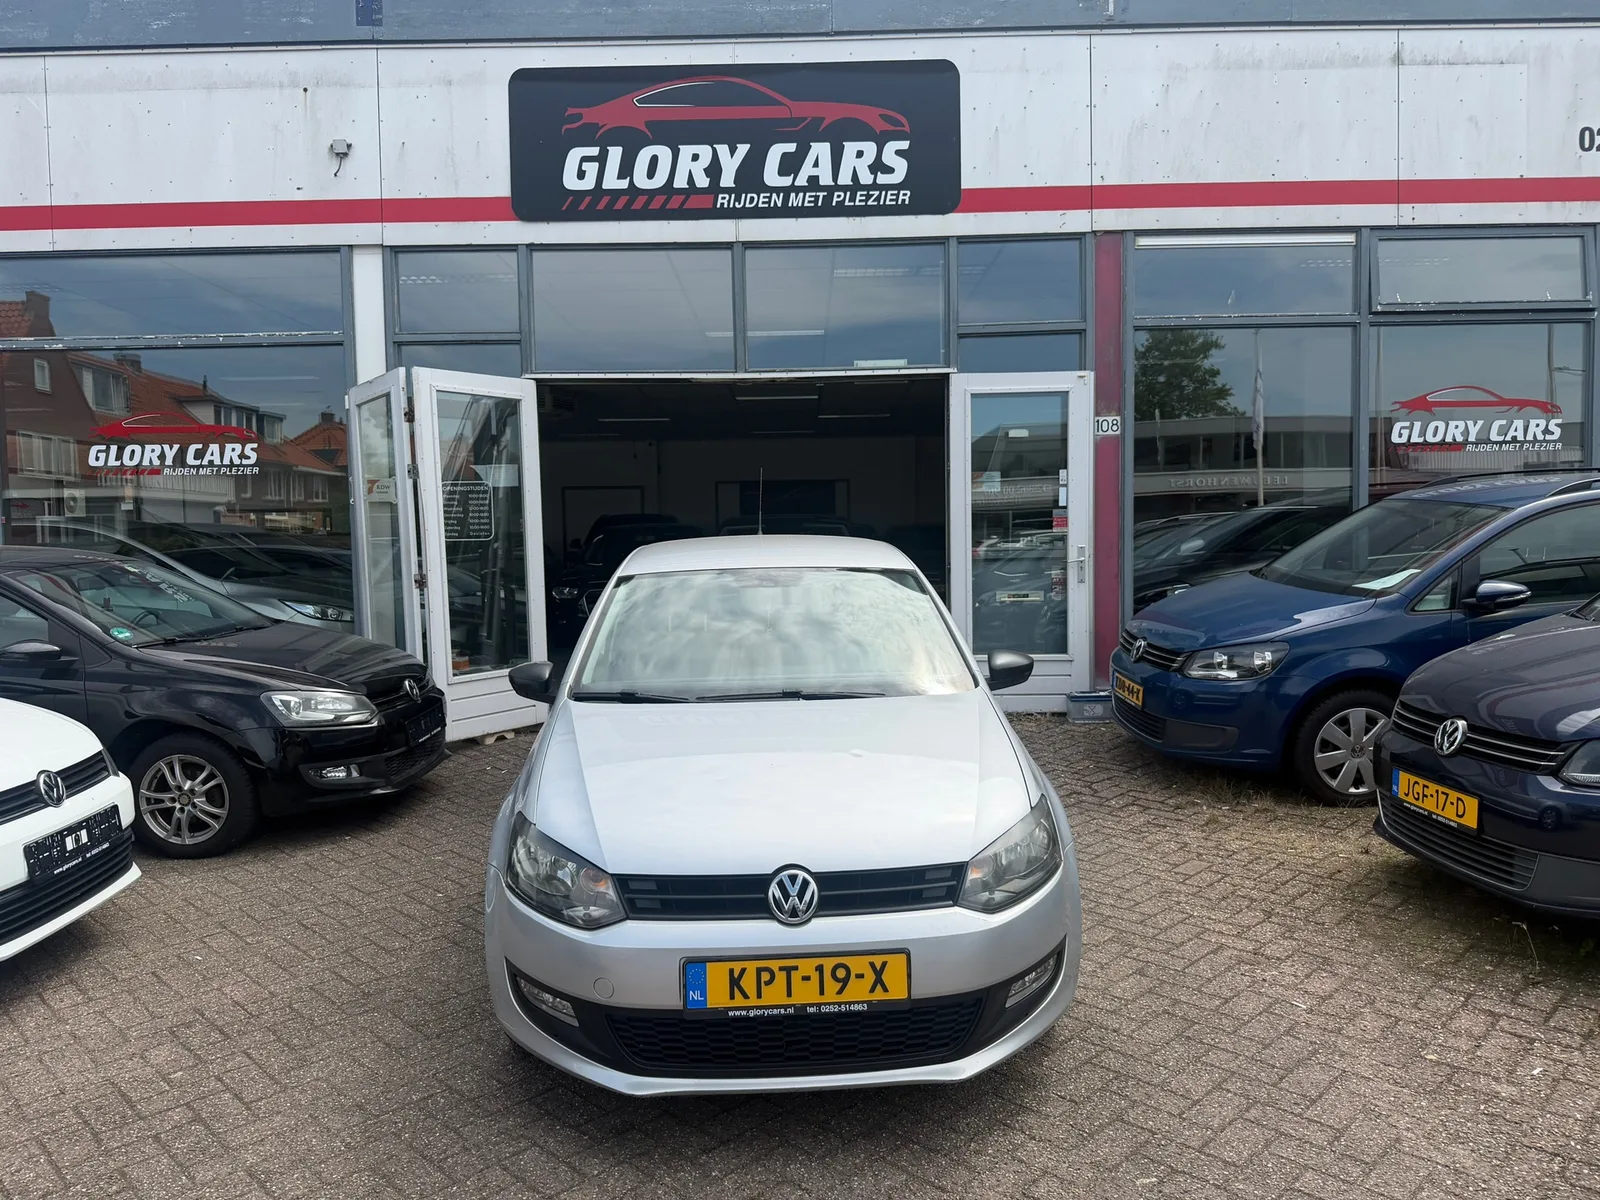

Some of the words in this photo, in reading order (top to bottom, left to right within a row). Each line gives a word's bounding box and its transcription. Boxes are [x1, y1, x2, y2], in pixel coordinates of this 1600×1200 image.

[1578, 126, 1600, 152] 0
[562, 143, 752, 190] GLORY
[763, 140, 911, 188] CARS
[716, 192, 786, 209] RIJDEN
[788, 191, 828, 207] MET
[831, 190, 911, 206] PLEZIER
[1095, 418, 1120, 433] 108
[1391, 420, 1485, 444] GLORY
[1489, 418, 1563, 442] CARS
[88, 443, 180, 467] GLORY
[186, 443, 259, 466] CARS
[1465, 444, 1499, 452] RIJDEN
[1501, 443, 1521, 451] MET
[1523, 442, 1563, 450] PLEZIER
[163, 468, 197, 476] RIJDEN
[198, 467, 218, 475] MET
[220, 467, 259, 475] PLEZIER
[1403, 778, 1467, 819] JGF-17-D
[728, 960, 890, 1001] KPT-19-X
[689, 990, 705, 1001] NL
[728, 1006, 795, 1017] www.glorycars.nl
[806, 1005, 820, 1013] tel:
[820, 1003, 868, 1013] 0252-514863
